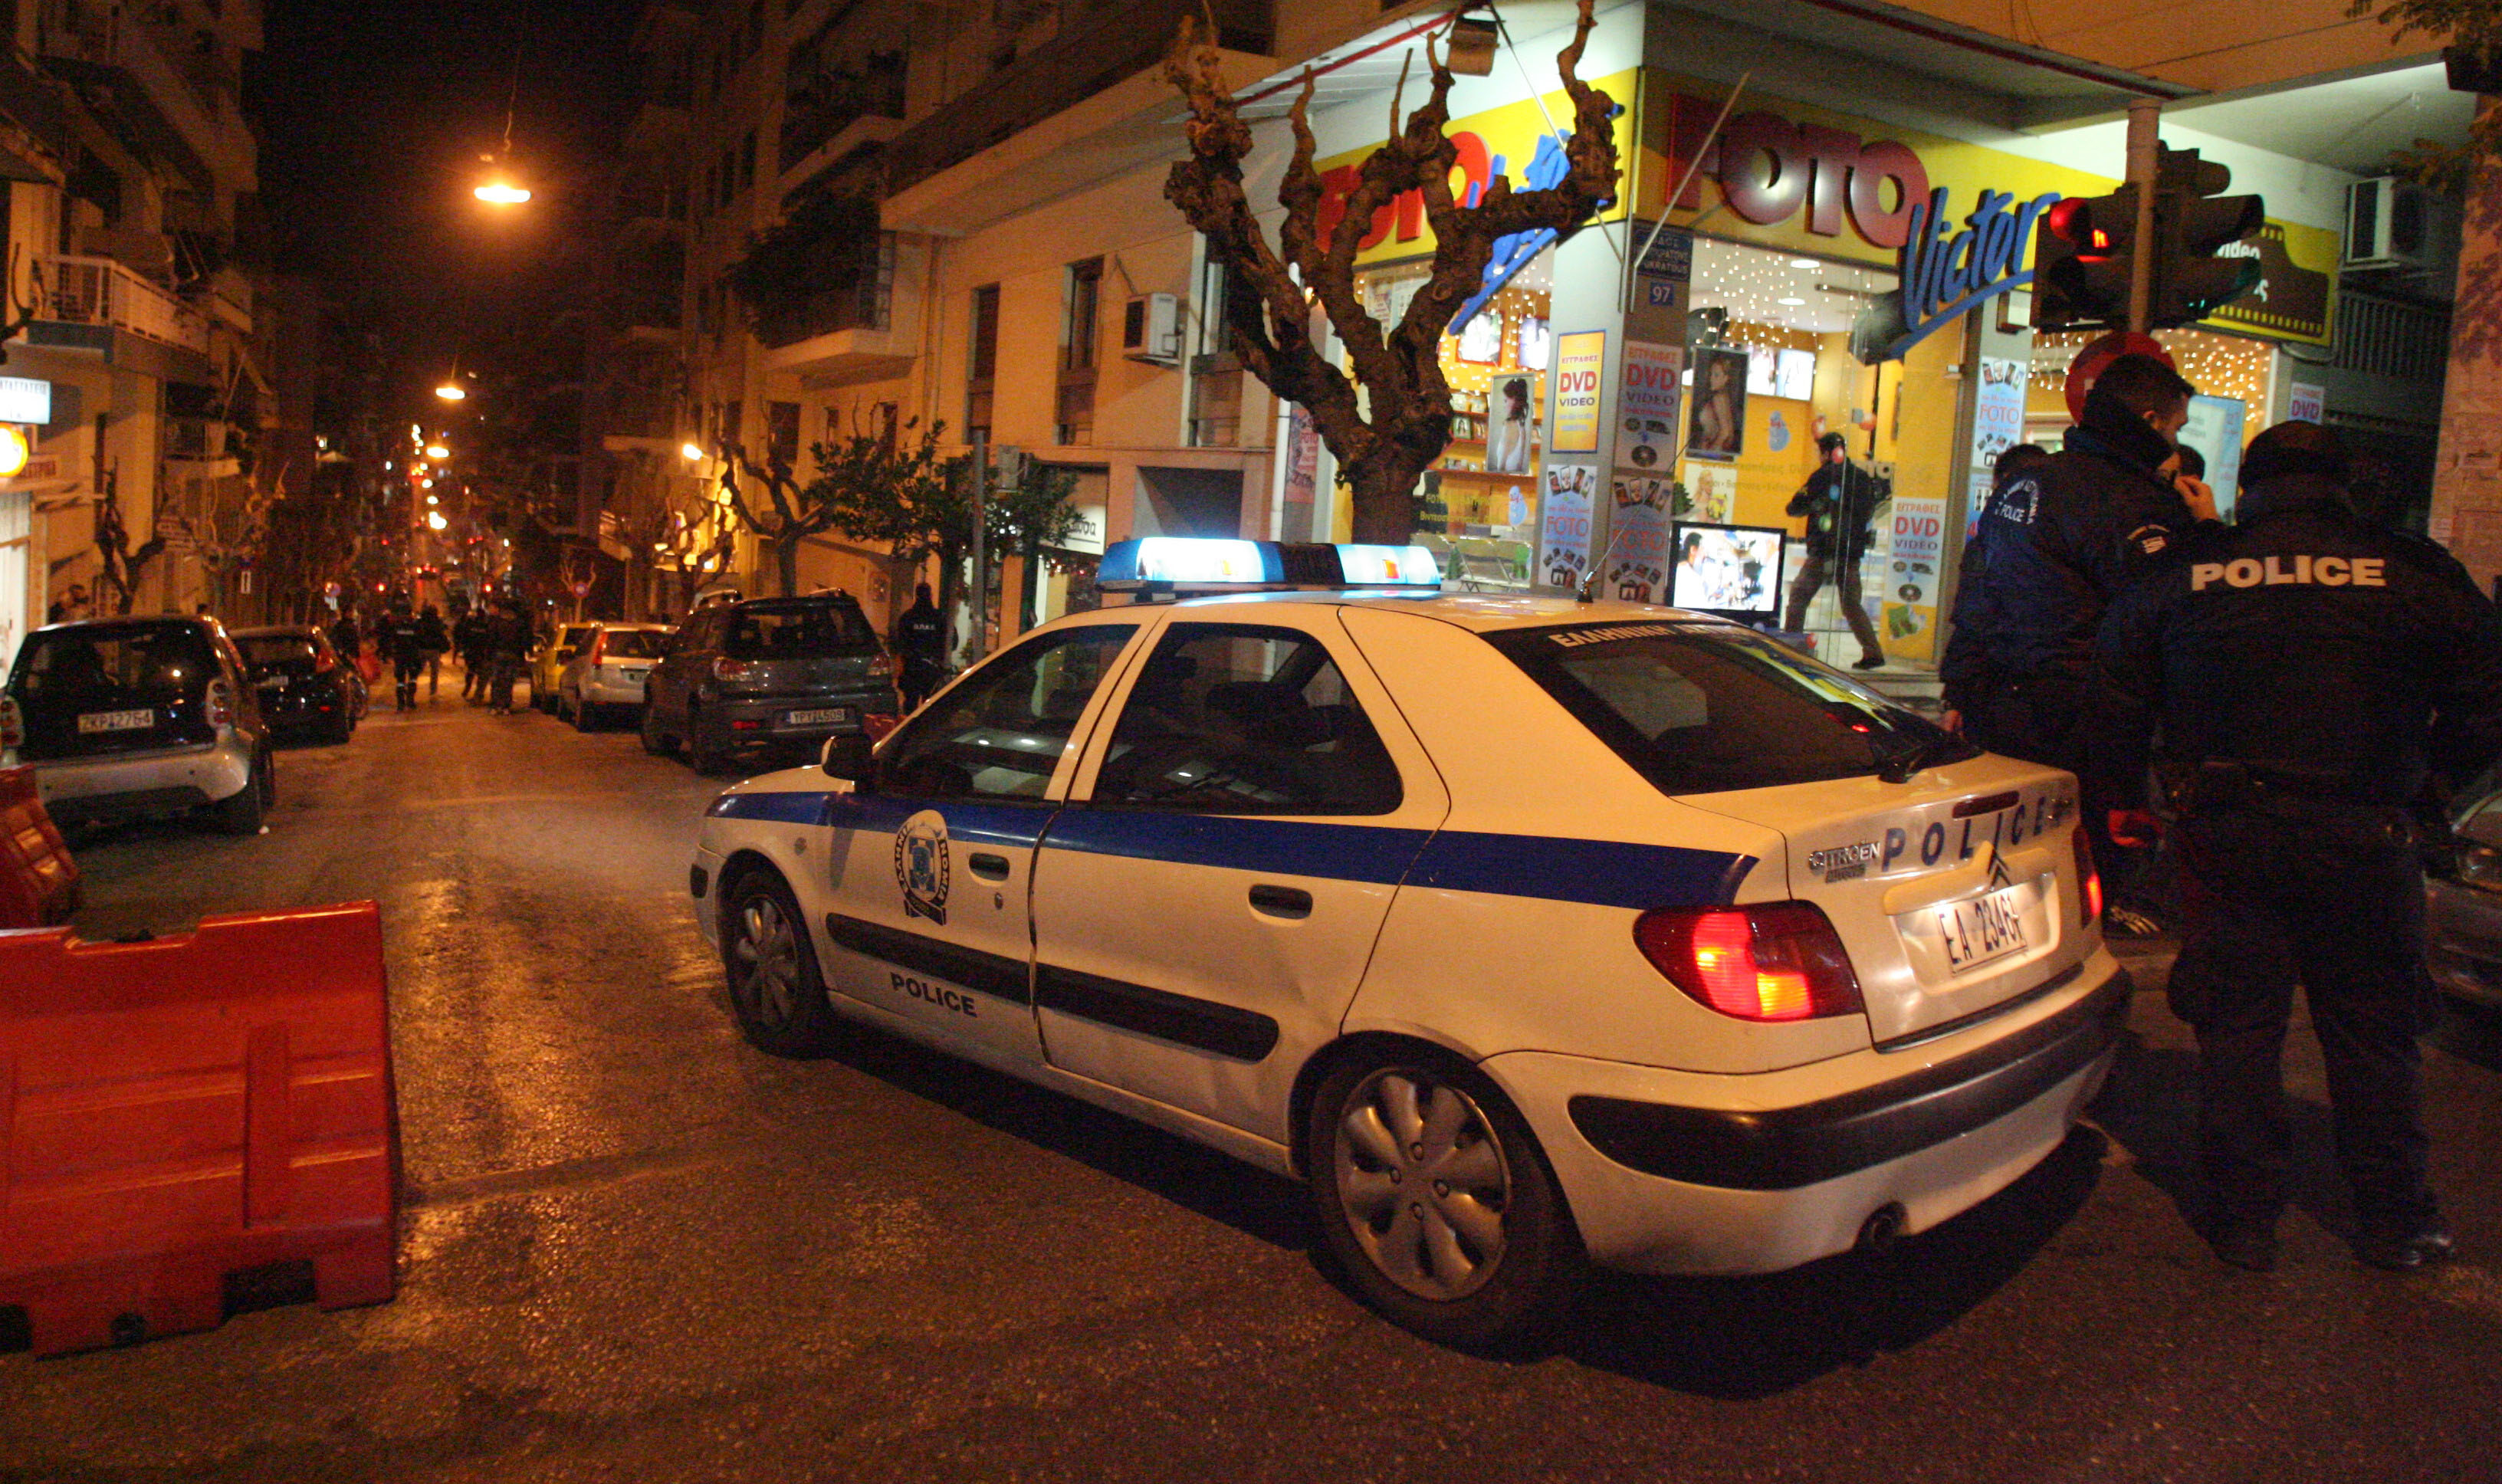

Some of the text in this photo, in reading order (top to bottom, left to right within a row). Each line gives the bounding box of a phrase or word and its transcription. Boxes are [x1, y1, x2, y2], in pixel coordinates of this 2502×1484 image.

[1666, 92, 1930, 249] FOTO
[1899, 186, 2062, 333] Victor
[1653, 286, 1671, 302] 97
[1559, 370, 1597, 393] DVD
[1626, 363, 1676, 392] DVD
[1559, 397, 1596, 407] VIDEO
[1626, 391, 1675, 407] VIDEO
[2291, 399, 2320, 421] DVD
[1979, 402, 2021, 425] FOTO
[2000, 503, 2025, 523] POLICE
[1545, 515, 1590, 537] FOTO
[1895, 516, 1940, 537] DVD
[1613, 529, 1666, 551] FOTO
[1895, 539, 1938, 551] VIDEO
[2192, 555, 2387, 591] POLICE
[1882, 796, 2047, 872] POLICE
[1940, 909, 1974, 965] EA
[890, 971, 978, 1018] POLICE
